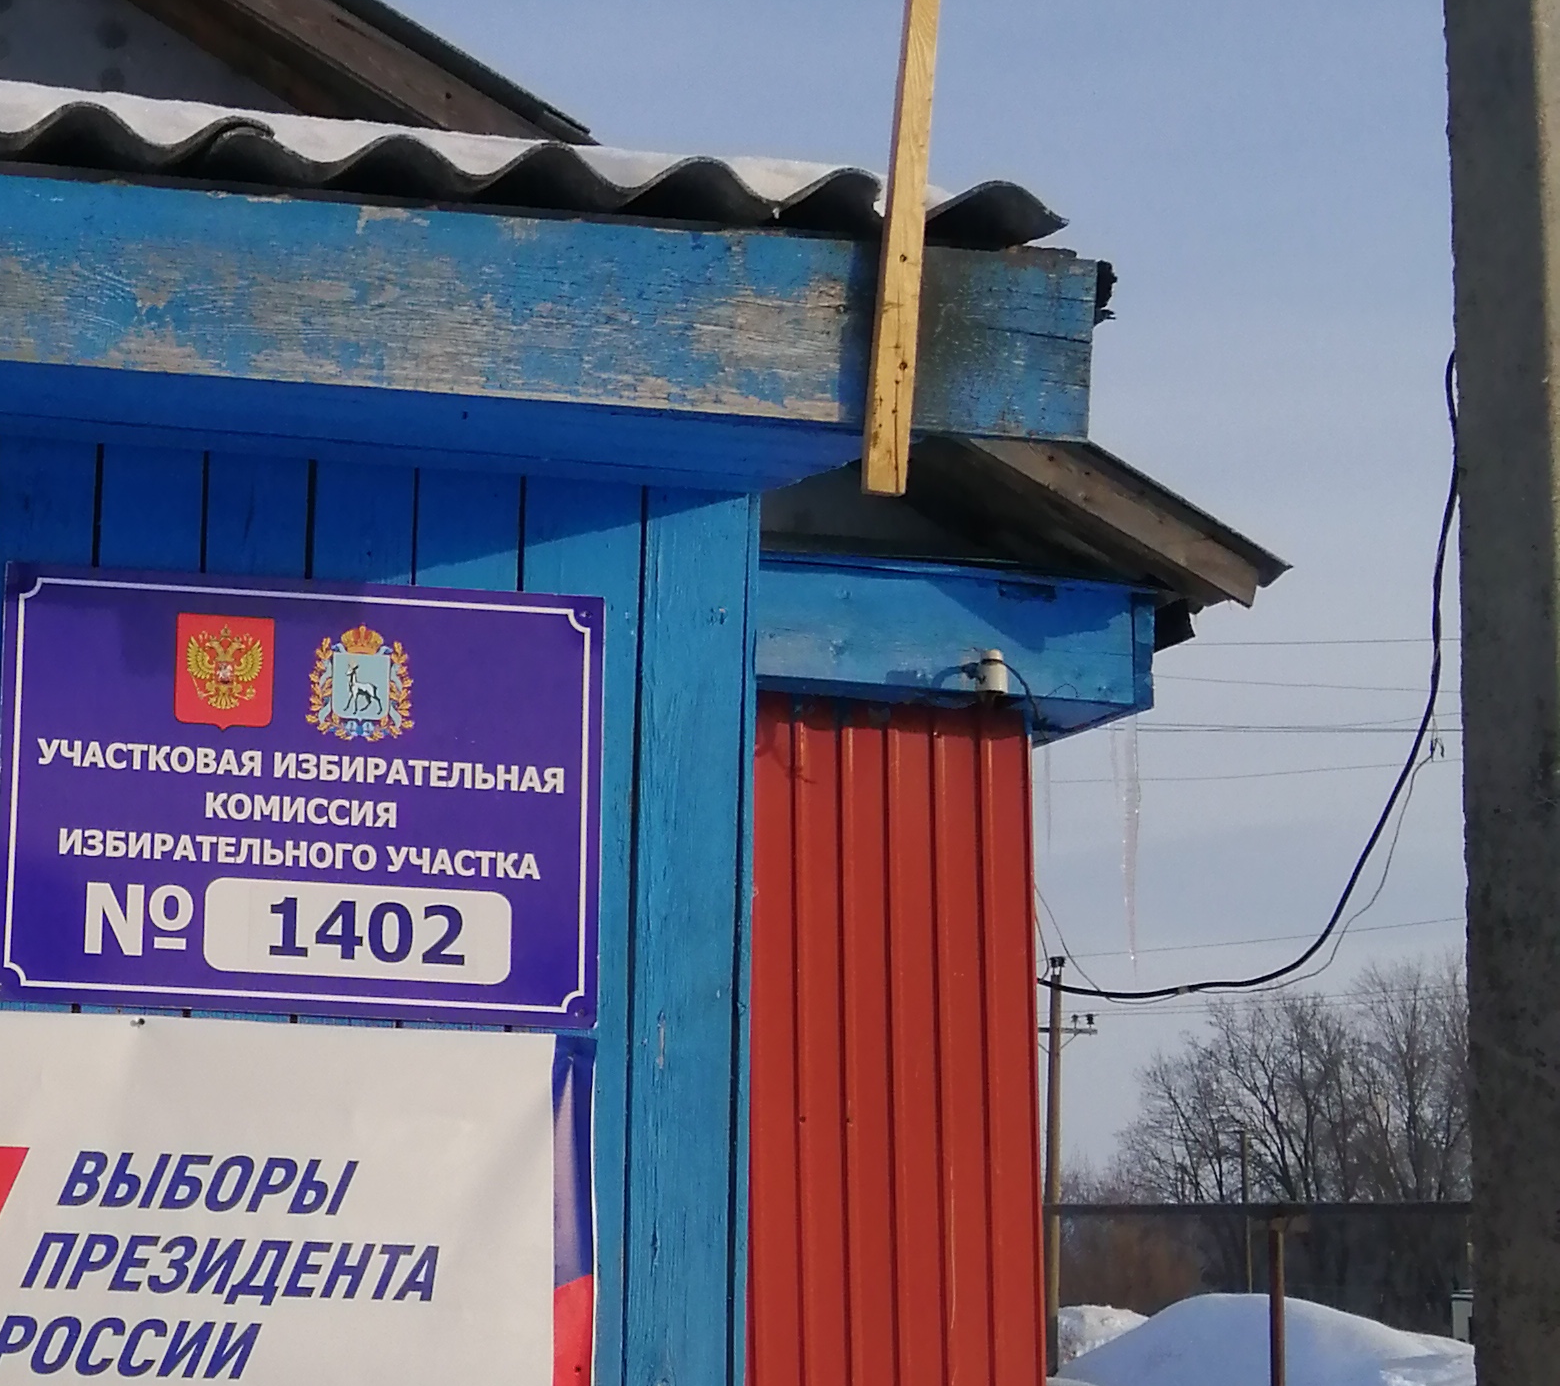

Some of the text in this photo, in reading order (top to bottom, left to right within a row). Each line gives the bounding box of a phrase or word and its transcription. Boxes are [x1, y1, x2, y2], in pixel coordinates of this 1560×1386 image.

[38, 738, 566, 795] УЧАСТКОВАЯ ИЗБИРАТЕЛЬНАЯ
[205, 791, 398, 829] КОМИССИЯ
[58, 827, 542, 881] ИЗБИРАТЕЛЬНОГО УЧАСТКА
[83, 881, 467, 967] № 1402
[57, 1150, 360, 1216] ВЫБОРЫ
[19, 1232, 440, 1307] ПРЕЗИДЕНТА
